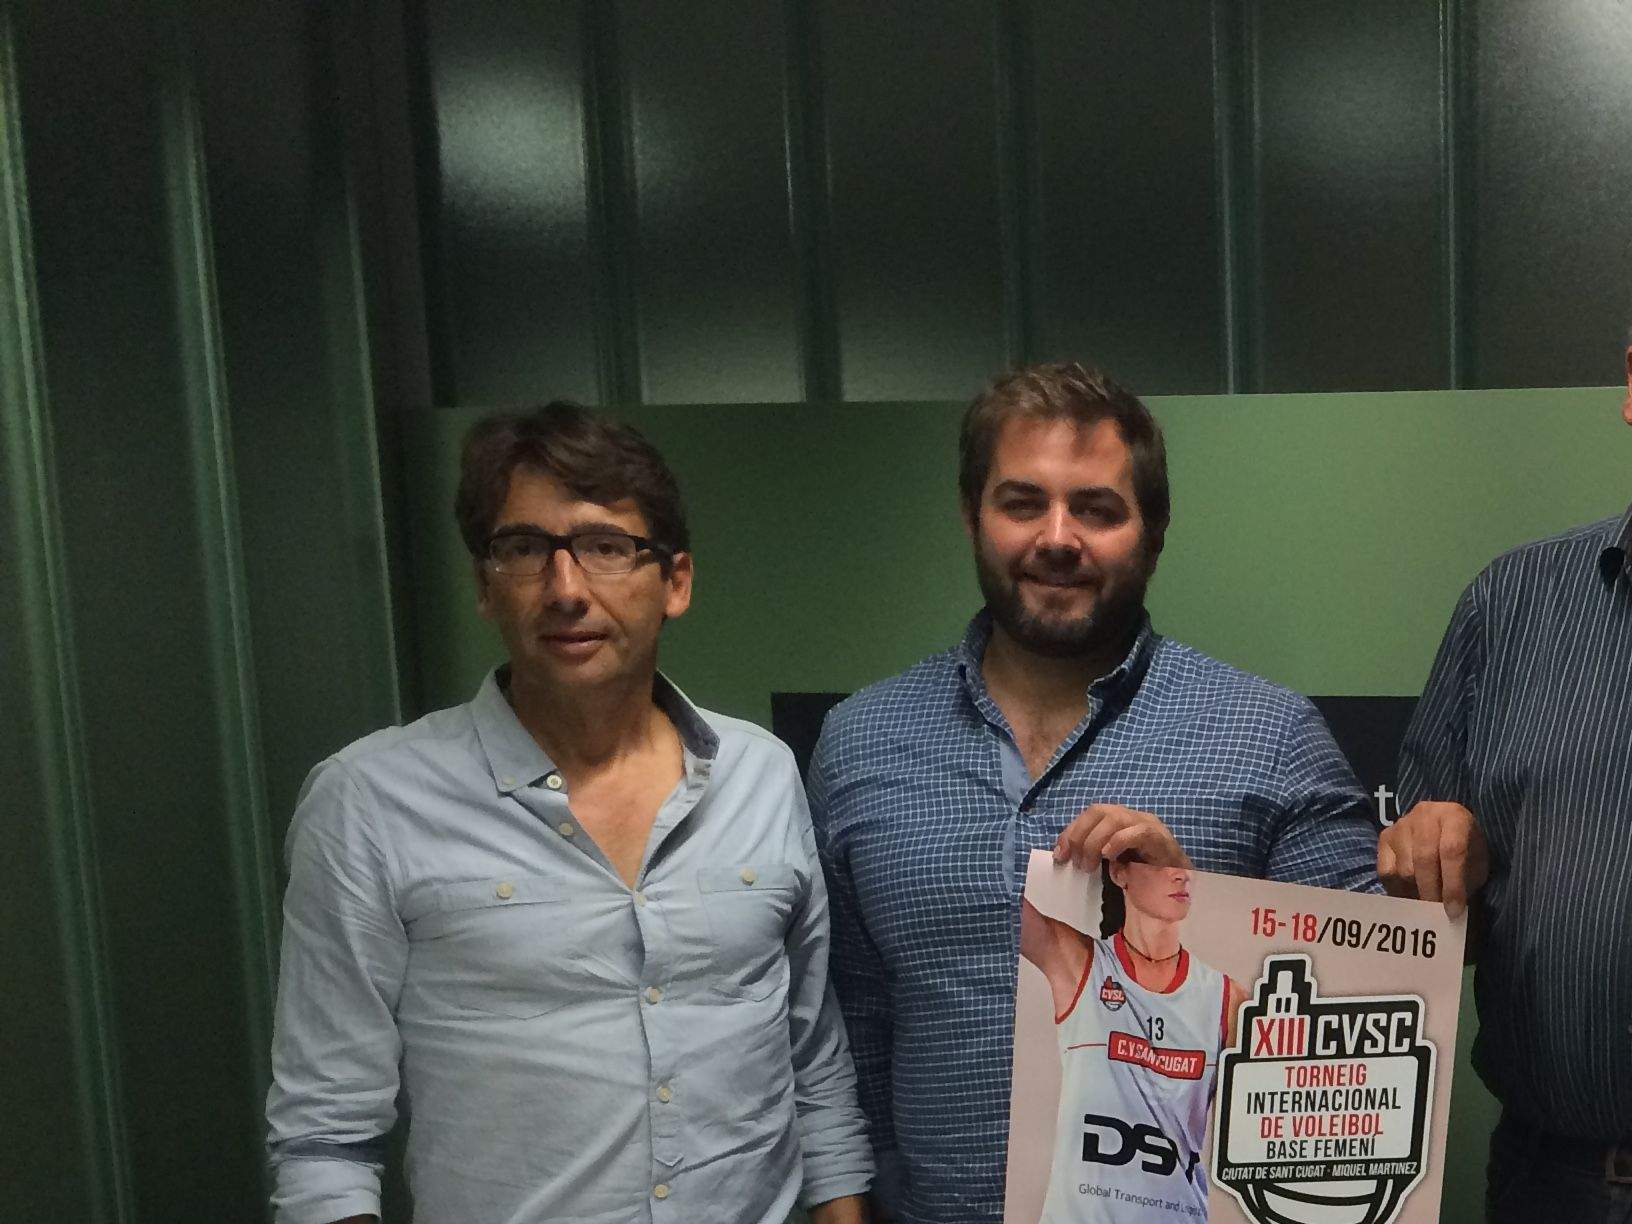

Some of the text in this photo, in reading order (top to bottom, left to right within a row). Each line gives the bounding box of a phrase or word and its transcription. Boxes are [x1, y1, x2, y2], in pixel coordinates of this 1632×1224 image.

[1250, 907, 1436, 959] 15-18/09/2016
[1147, 1016, 1164, 1040] 13
[1254, 1012, 1413, 1056] XIII CVSC
[1285, 1063, 1367, 1088] TORNEIG
[1247, 1087, 1401, 1114] INTERNACIONAL
[1261, 1113, 1383, 1138] DE VOLEIBOL
[1267, 1134, 1375, 1159] BASE FEMENÍ
[1222, 1162, 1417, 1180] CIUTAT DE SANT CUGAT MIQUEL MARTINEZ
[1079, 1183, 1111, 1198] Global
[1115, 1189, 1163, 1208] Transport
